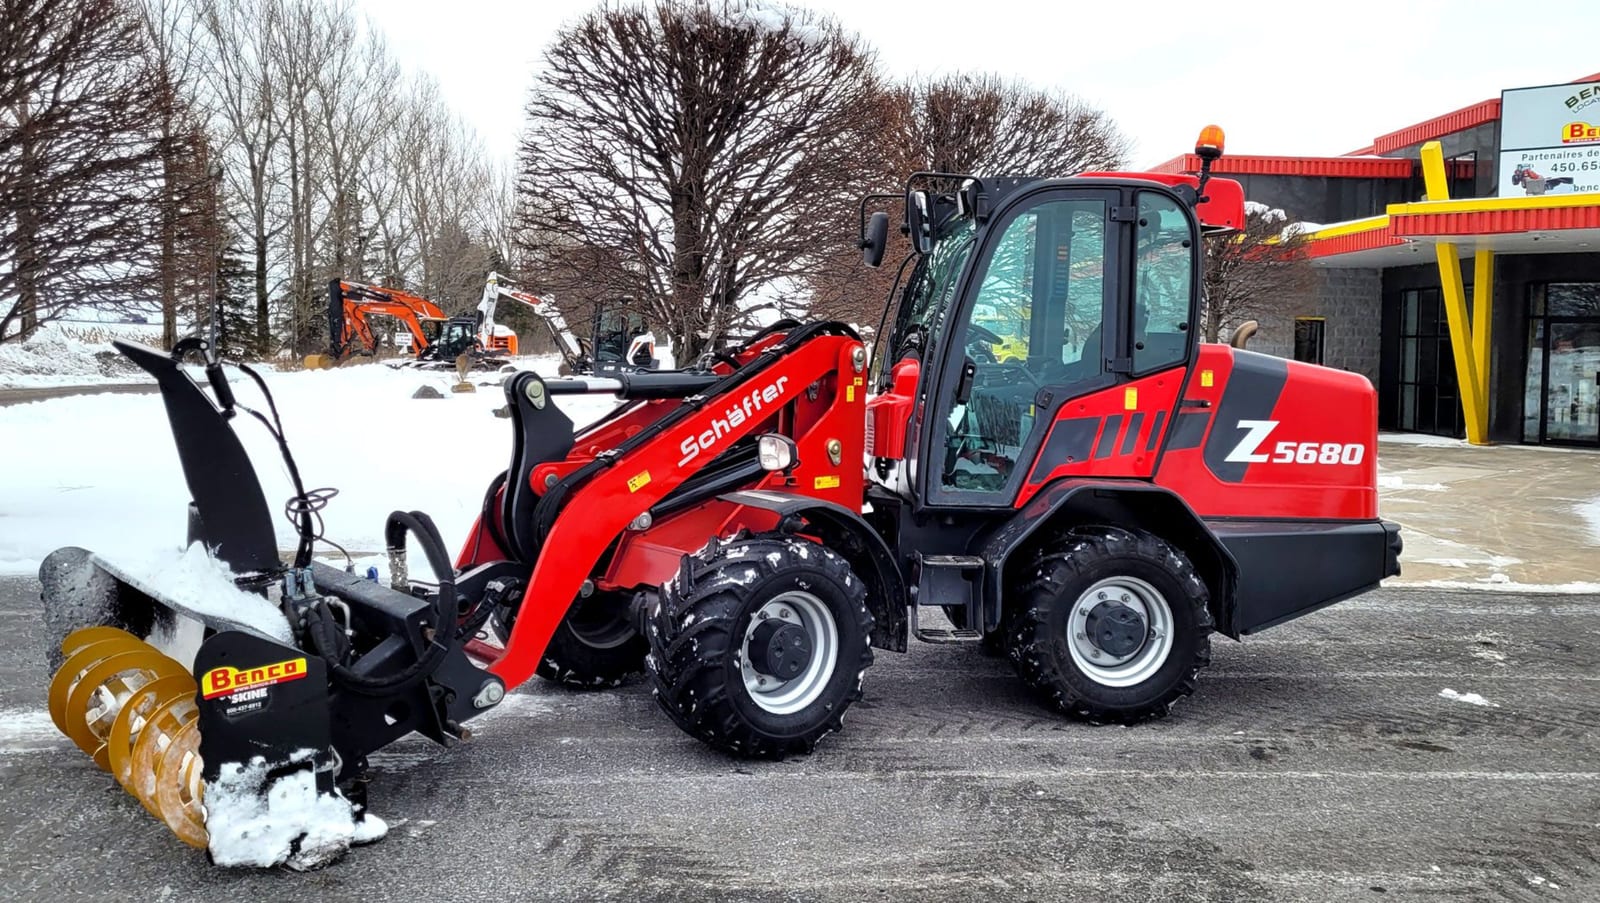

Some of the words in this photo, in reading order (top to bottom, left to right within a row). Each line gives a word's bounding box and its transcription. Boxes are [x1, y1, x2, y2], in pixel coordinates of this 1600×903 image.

[1521, 150, 1583, 162] Partenaires
[1586, 149, 1600, 158] de
[1550, 161, 1600, 173] 450.65
[677, 375, 789, 468] Schäffer
[219, 688, 268, 703] SKINE
